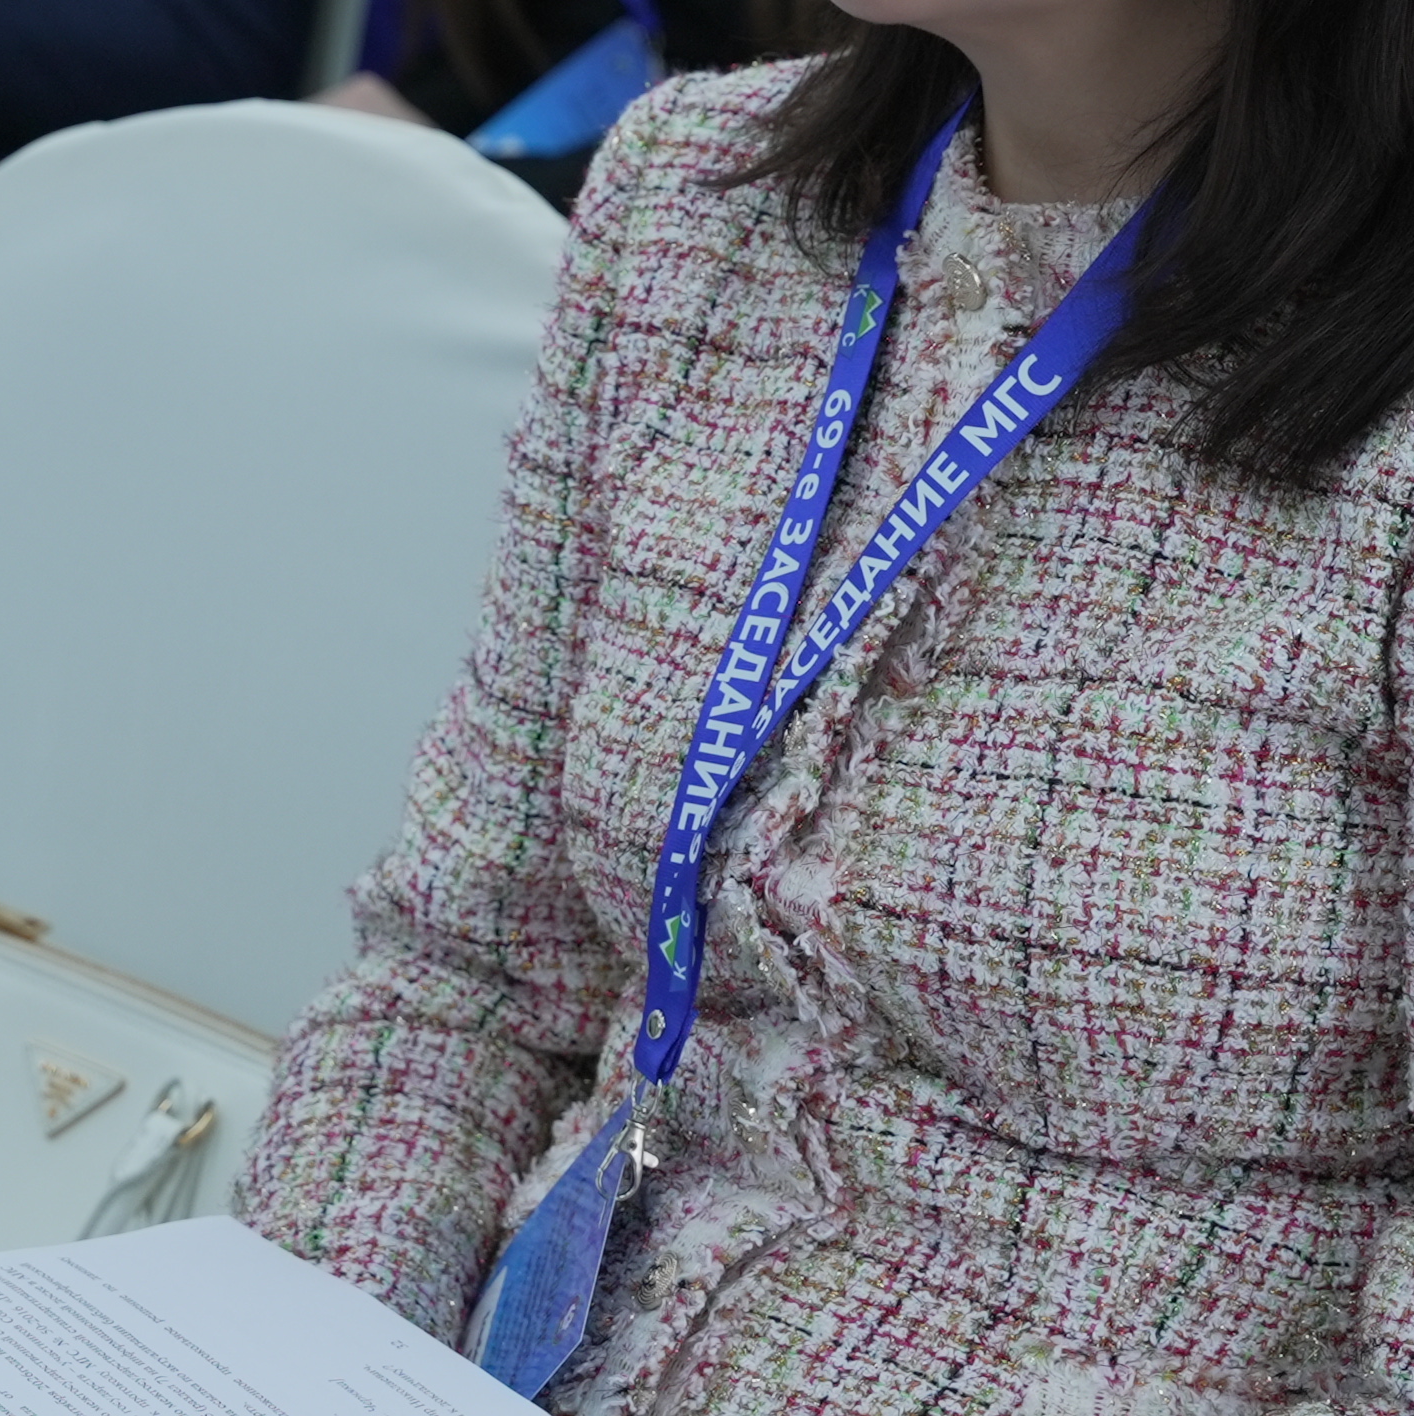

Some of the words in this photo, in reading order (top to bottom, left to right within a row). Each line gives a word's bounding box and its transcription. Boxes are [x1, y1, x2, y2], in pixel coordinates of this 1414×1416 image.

[751, 450, 970, 740] ЗАСЕДАНИЕ
[958, 353, 1063, 458] МГС
[795, 388, 853, 501] 69-е
[676, 517, 814, 832] ЗАСЕДАНИЕ
